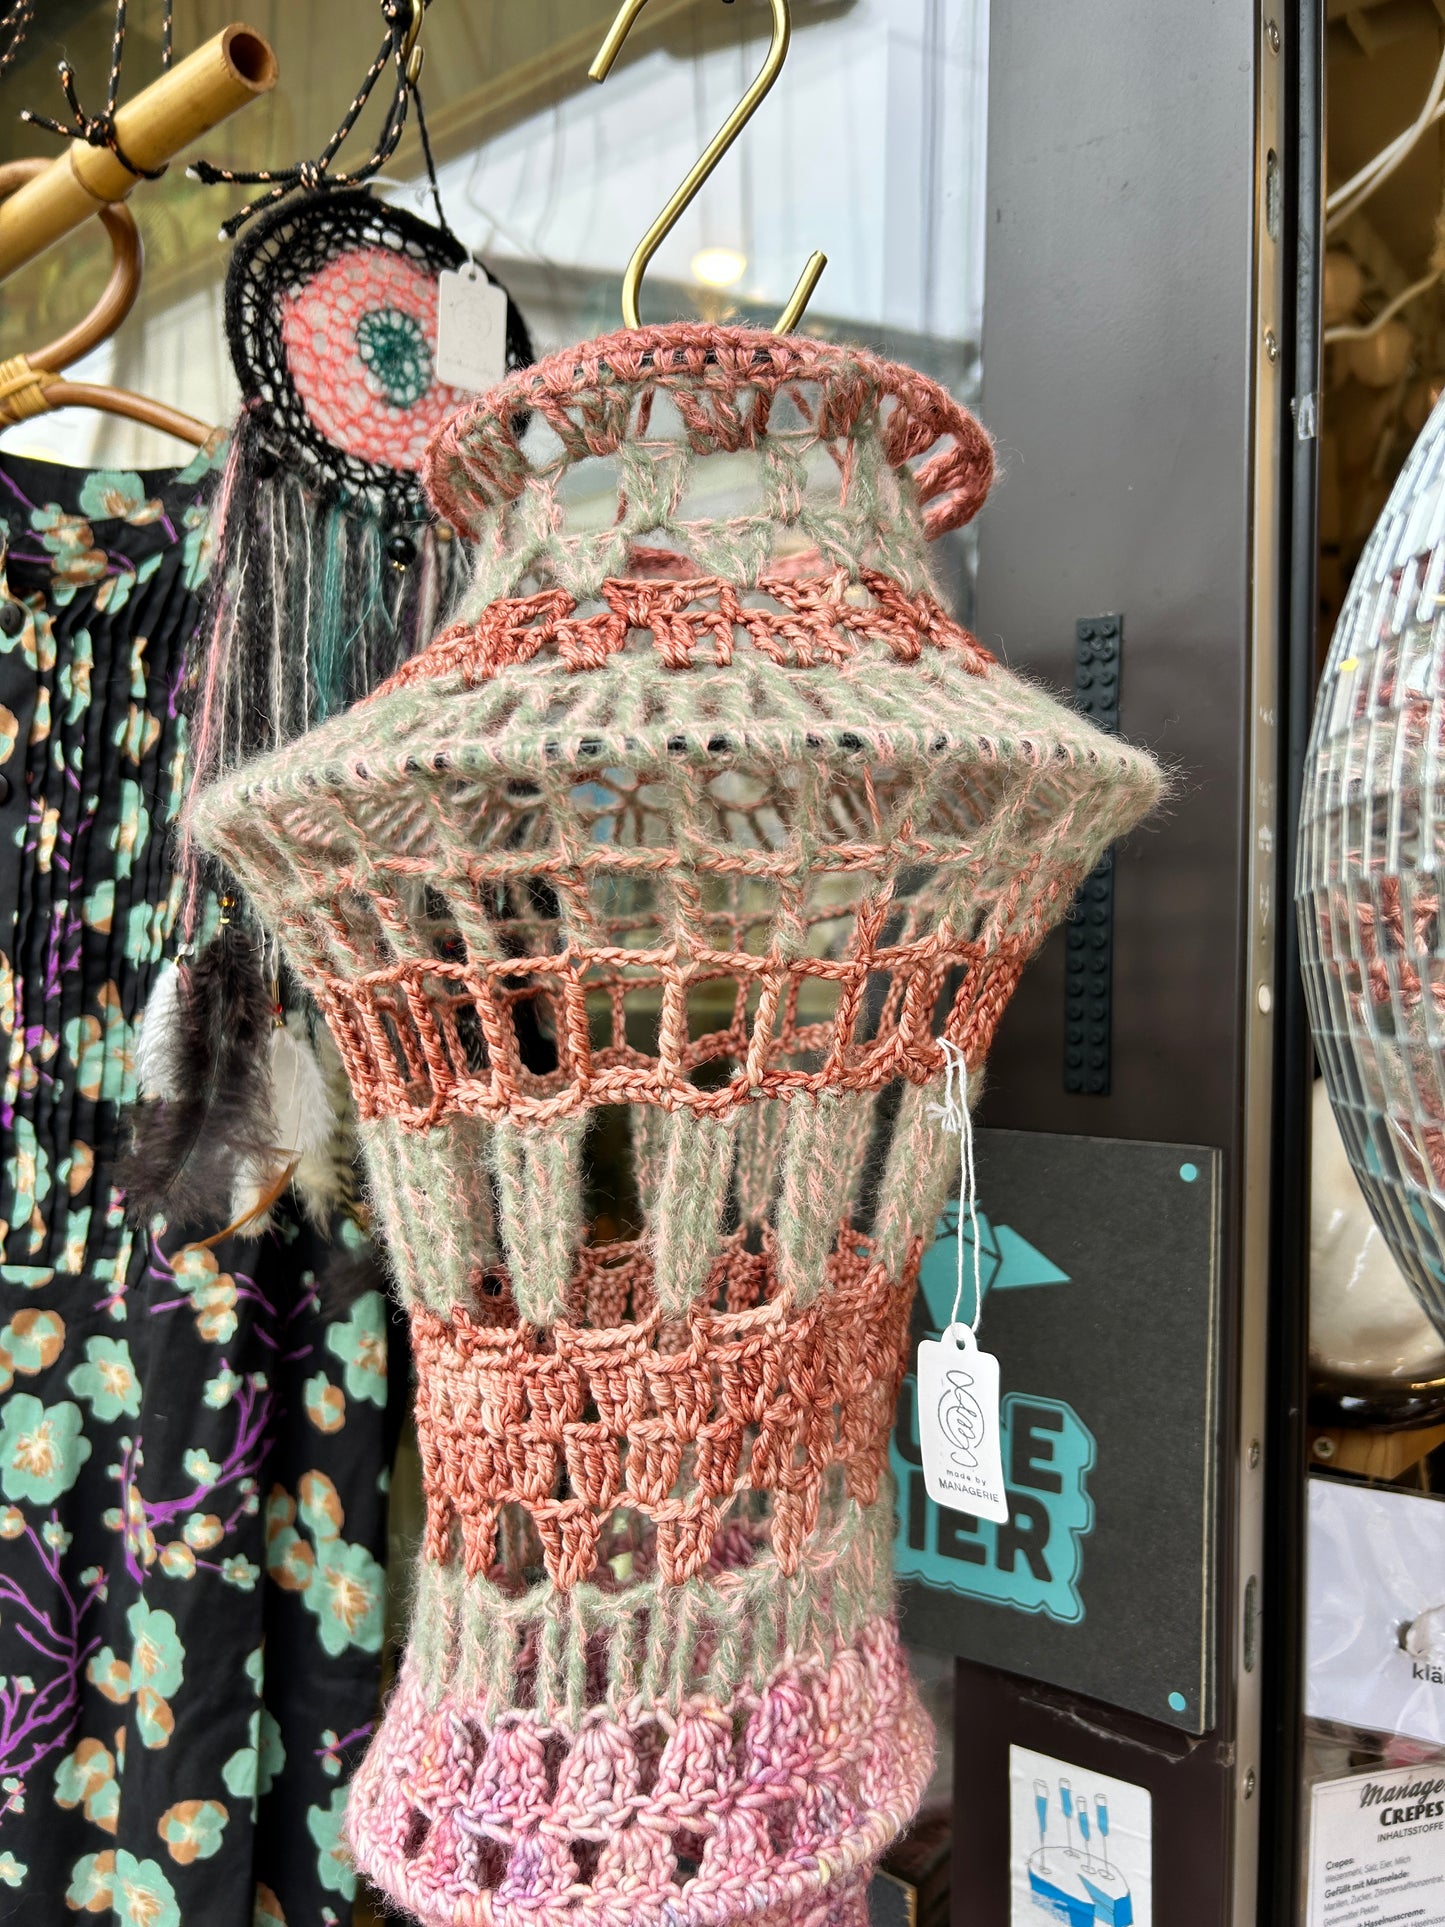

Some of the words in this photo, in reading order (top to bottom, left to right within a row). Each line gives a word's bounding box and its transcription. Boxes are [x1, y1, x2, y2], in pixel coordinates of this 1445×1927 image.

[938, 1477, 1000, 1503] MANAGERIE
[946, 1469, 971, 1481] made
[975, 1476, 987, 1487] by
[907, 1469, 1053, 1583] IER
[1412, 1662, 1445, 1685] klä
[1360, 1778, 1445, 1809] Manage
[1380, 1800, 1444, 1827] CREPES
[1376, 1821, 1444, 1843] INHALTSSTOFFE
[1352, 1879, 1364, 1890] mit
